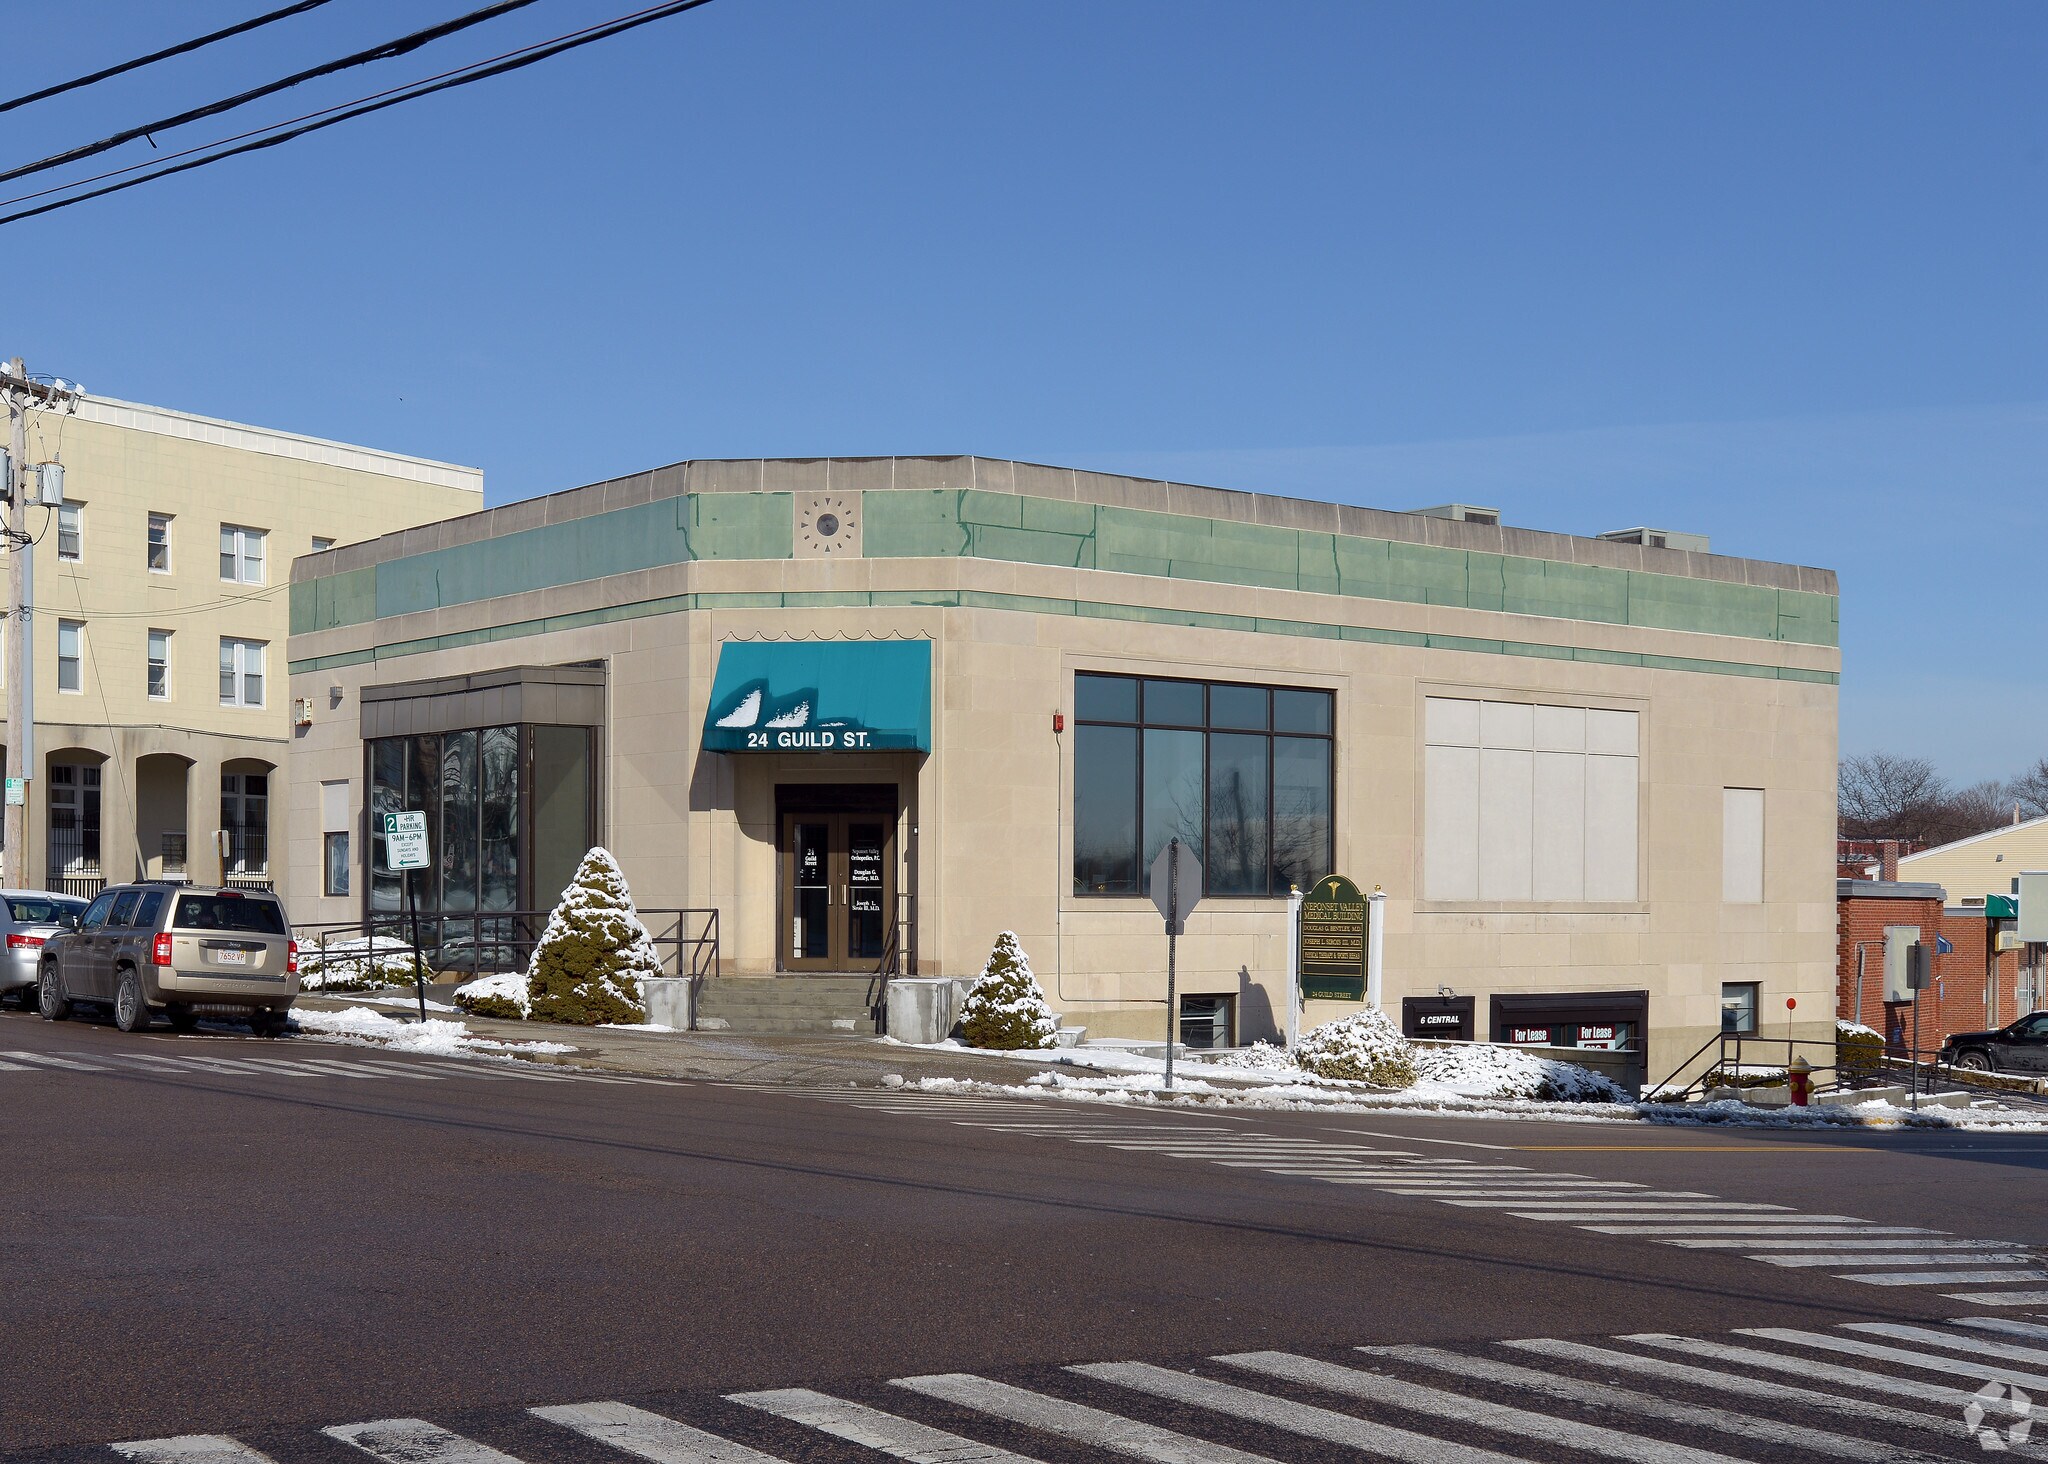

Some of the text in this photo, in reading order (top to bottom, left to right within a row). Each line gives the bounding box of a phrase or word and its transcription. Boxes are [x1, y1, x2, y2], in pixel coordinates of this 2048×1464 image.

[748, 732, 870, 747] 24 GUILD ST.
[387, 817, 396, 831] 2
[400, 822, 422, 830] PARKING
[1304, 902, 1364, 912] NEPONSET VALLEY
[1304, 912, 1364, 920] MEDICAL BUILDING
[220, 952, 235, 960] 7652
[1427, 1015, 1460, 1024] CENTRAL
[1515, 1029, 1547, 1042] For Lease
[1581, 1026, 1612, 1039] For Lease
